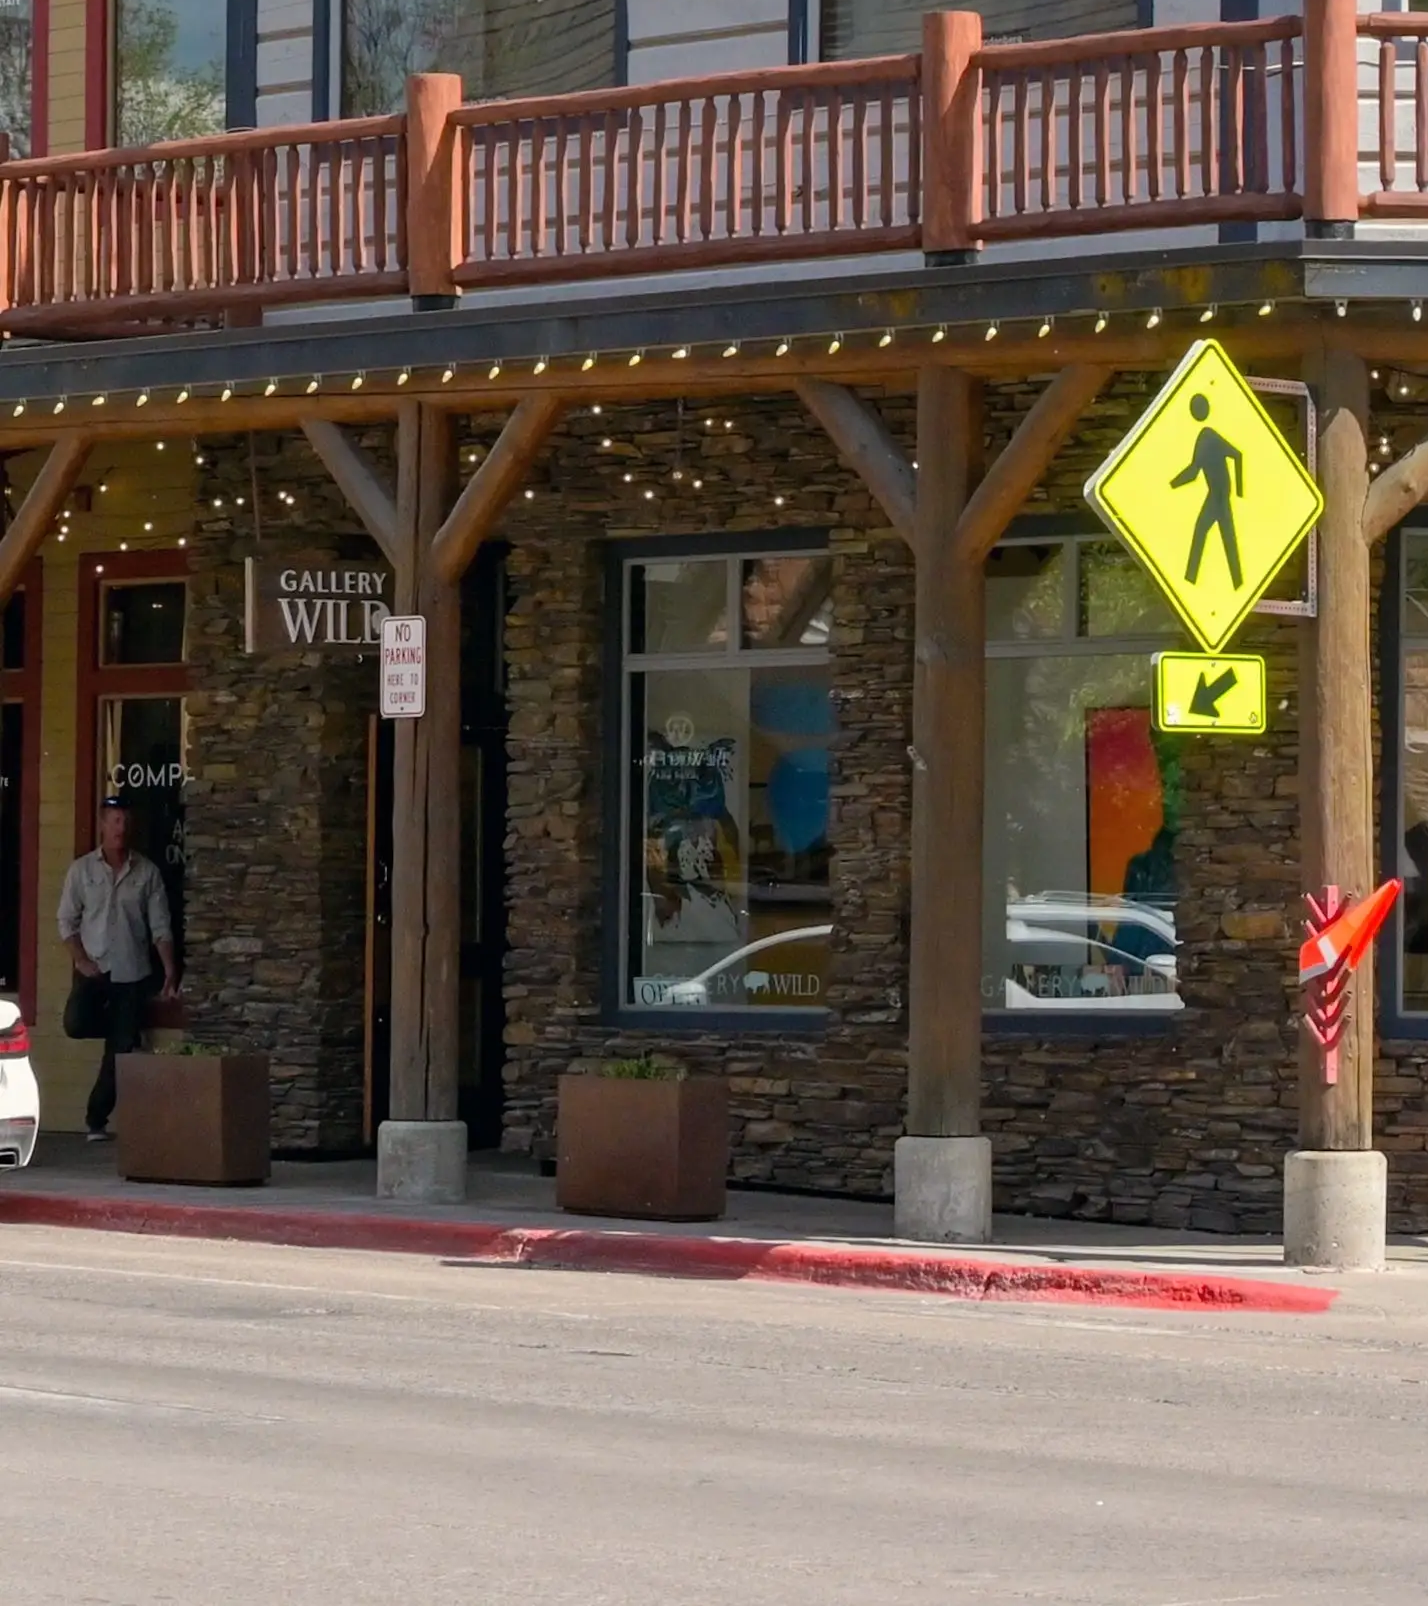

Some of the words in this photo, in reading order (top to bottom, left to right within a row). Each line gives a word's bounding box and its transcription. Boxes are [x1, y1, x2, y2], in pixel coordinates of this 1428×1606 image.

[280, 569, 387, 594] GALLERY
[277, 597, 392, 644] WILD
[395, 623, 412, 642] NO
[385, 646, 422, 665] PARKING
[772, 973, 821, 996] WILD
